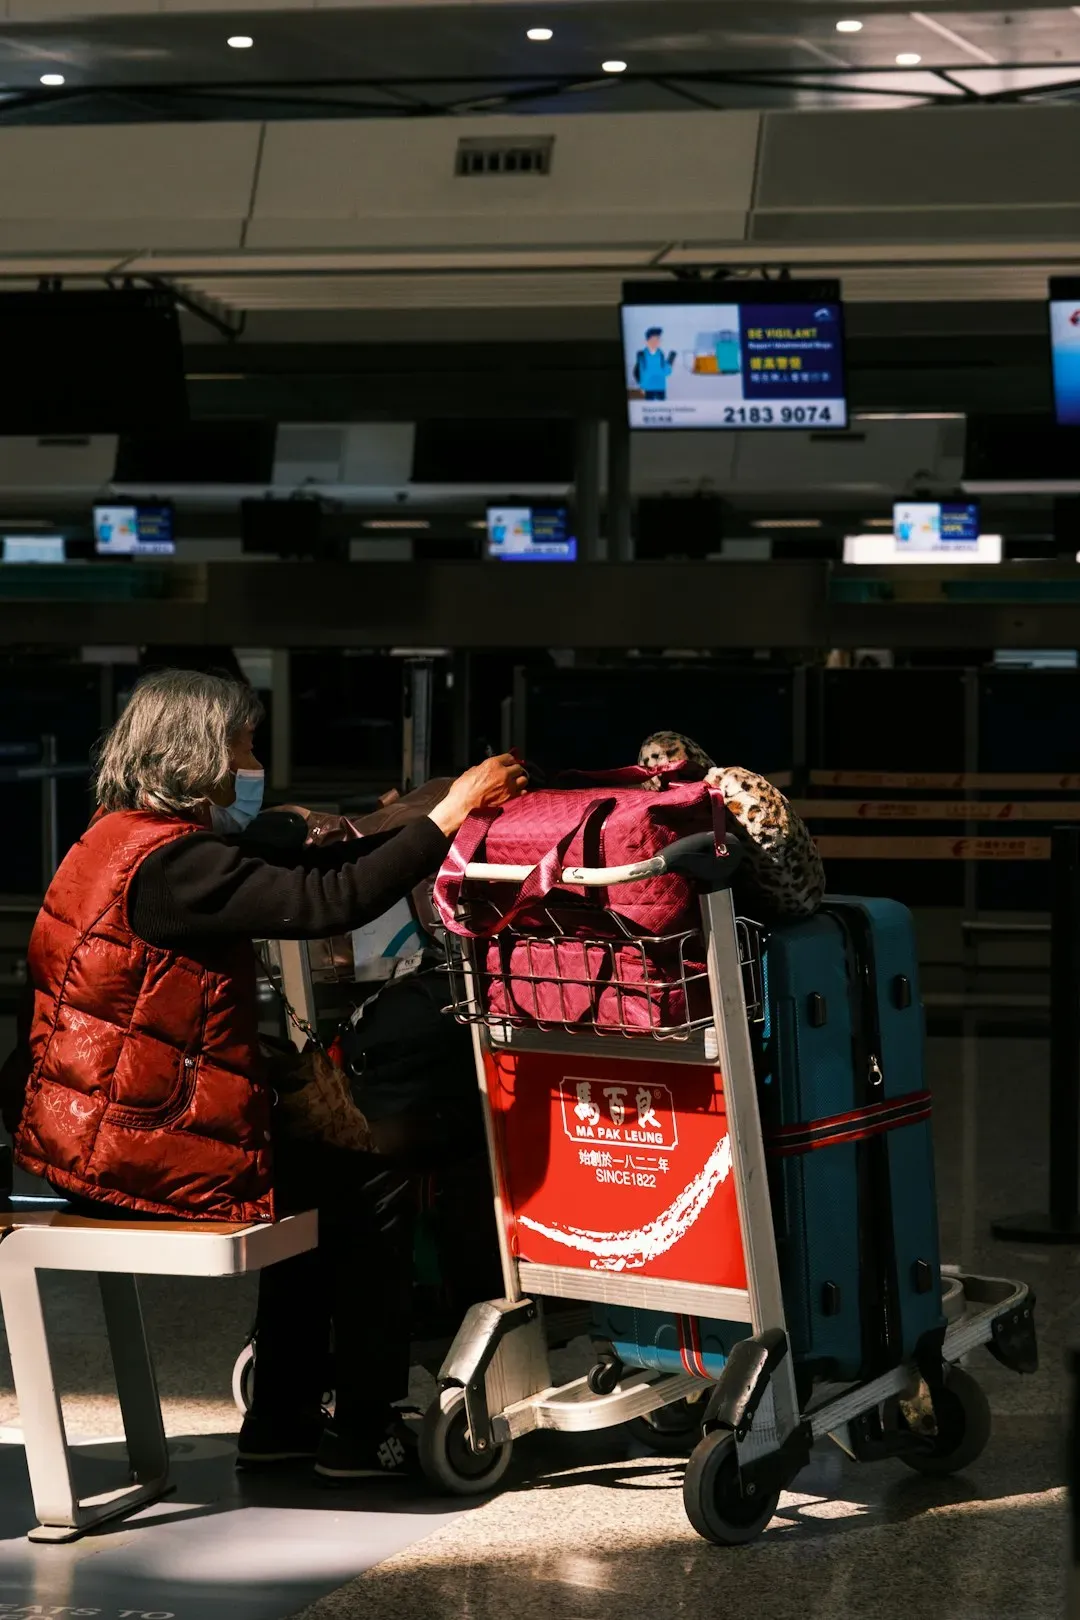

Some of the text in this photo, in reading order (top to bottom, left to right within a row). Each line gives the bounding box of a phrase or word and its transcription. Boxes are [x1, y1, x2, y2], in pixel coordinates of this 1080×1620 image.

[724, 406, 832, 424] 2183 9074
[576, 1125, 664, 1145] MA PAK LEUNG
[578, 1149, 670, 1174] 始創於一八二二年
[118, 1609, 175, 1620] TO
